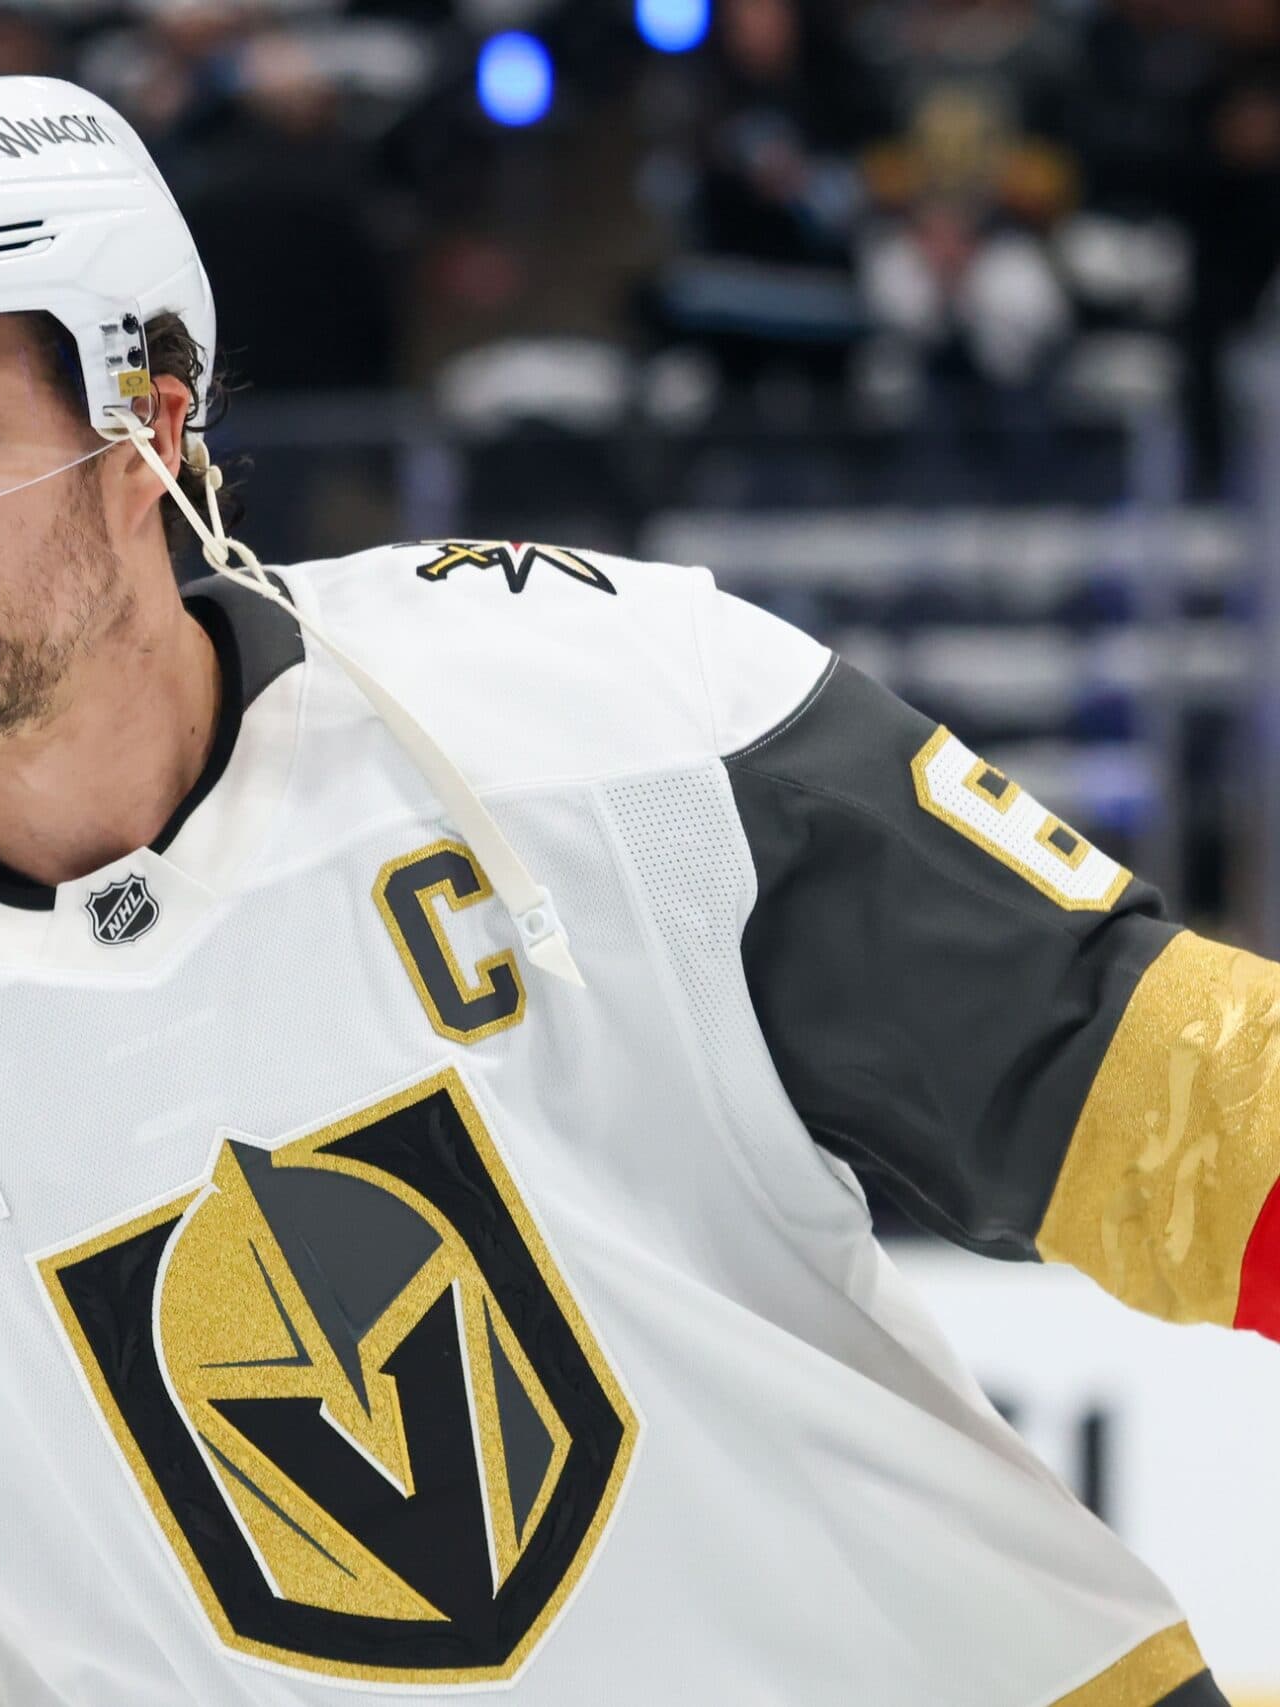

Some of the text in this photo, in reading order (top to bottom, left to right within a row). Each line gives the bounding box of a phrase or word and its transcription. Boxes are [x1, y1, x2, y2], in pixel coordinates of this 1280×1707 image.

[15, 114, 116, 147] NAQVI
[107, 890, 142, 939] NHL
[371, 838, 526, 1046] C
